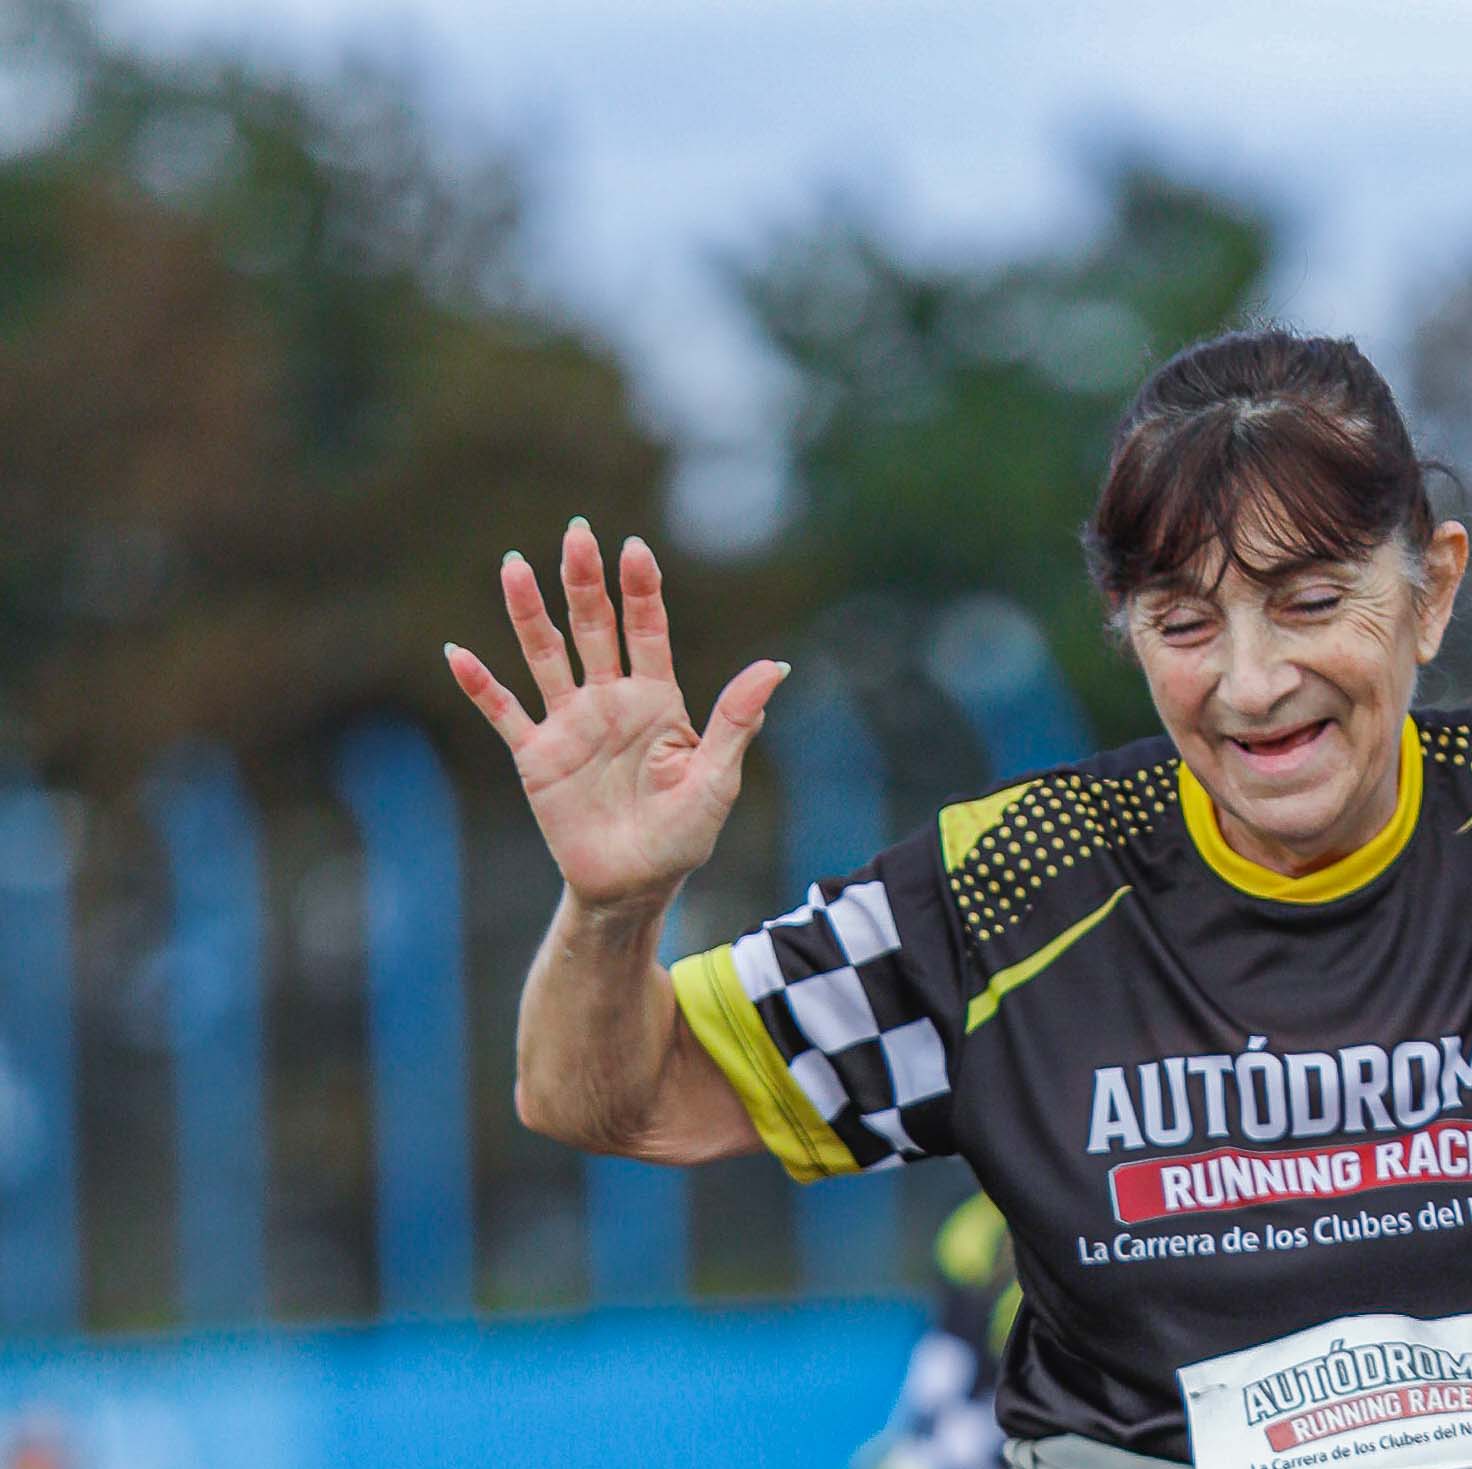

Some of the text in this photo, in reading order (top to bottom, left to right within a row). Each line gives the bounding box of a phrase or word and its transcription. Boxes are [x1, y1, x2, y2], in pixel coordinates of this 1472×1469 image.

[1161, 1148, 1361, 1211] RUNNING
[1078, 1235, 1110, 1266] La
[1112, 1231, 1216, 1262] Carrera
[1221, 1226, 1260, 1254] de
[1265, 1224, 1309, 1251] los
[1312, 1210, 1414, 1245] Clubes
[1418, 1200, 1464, 1231] del
[1290, 1391, 1402, 1444] RUNNING
[1332, 1442, 1352, 1461] de
[1354, 1438, 1377, 1456] los
[1379, 1430, 1430, 1451] Clubes
[1433, 1422, 1457, 1441] del
